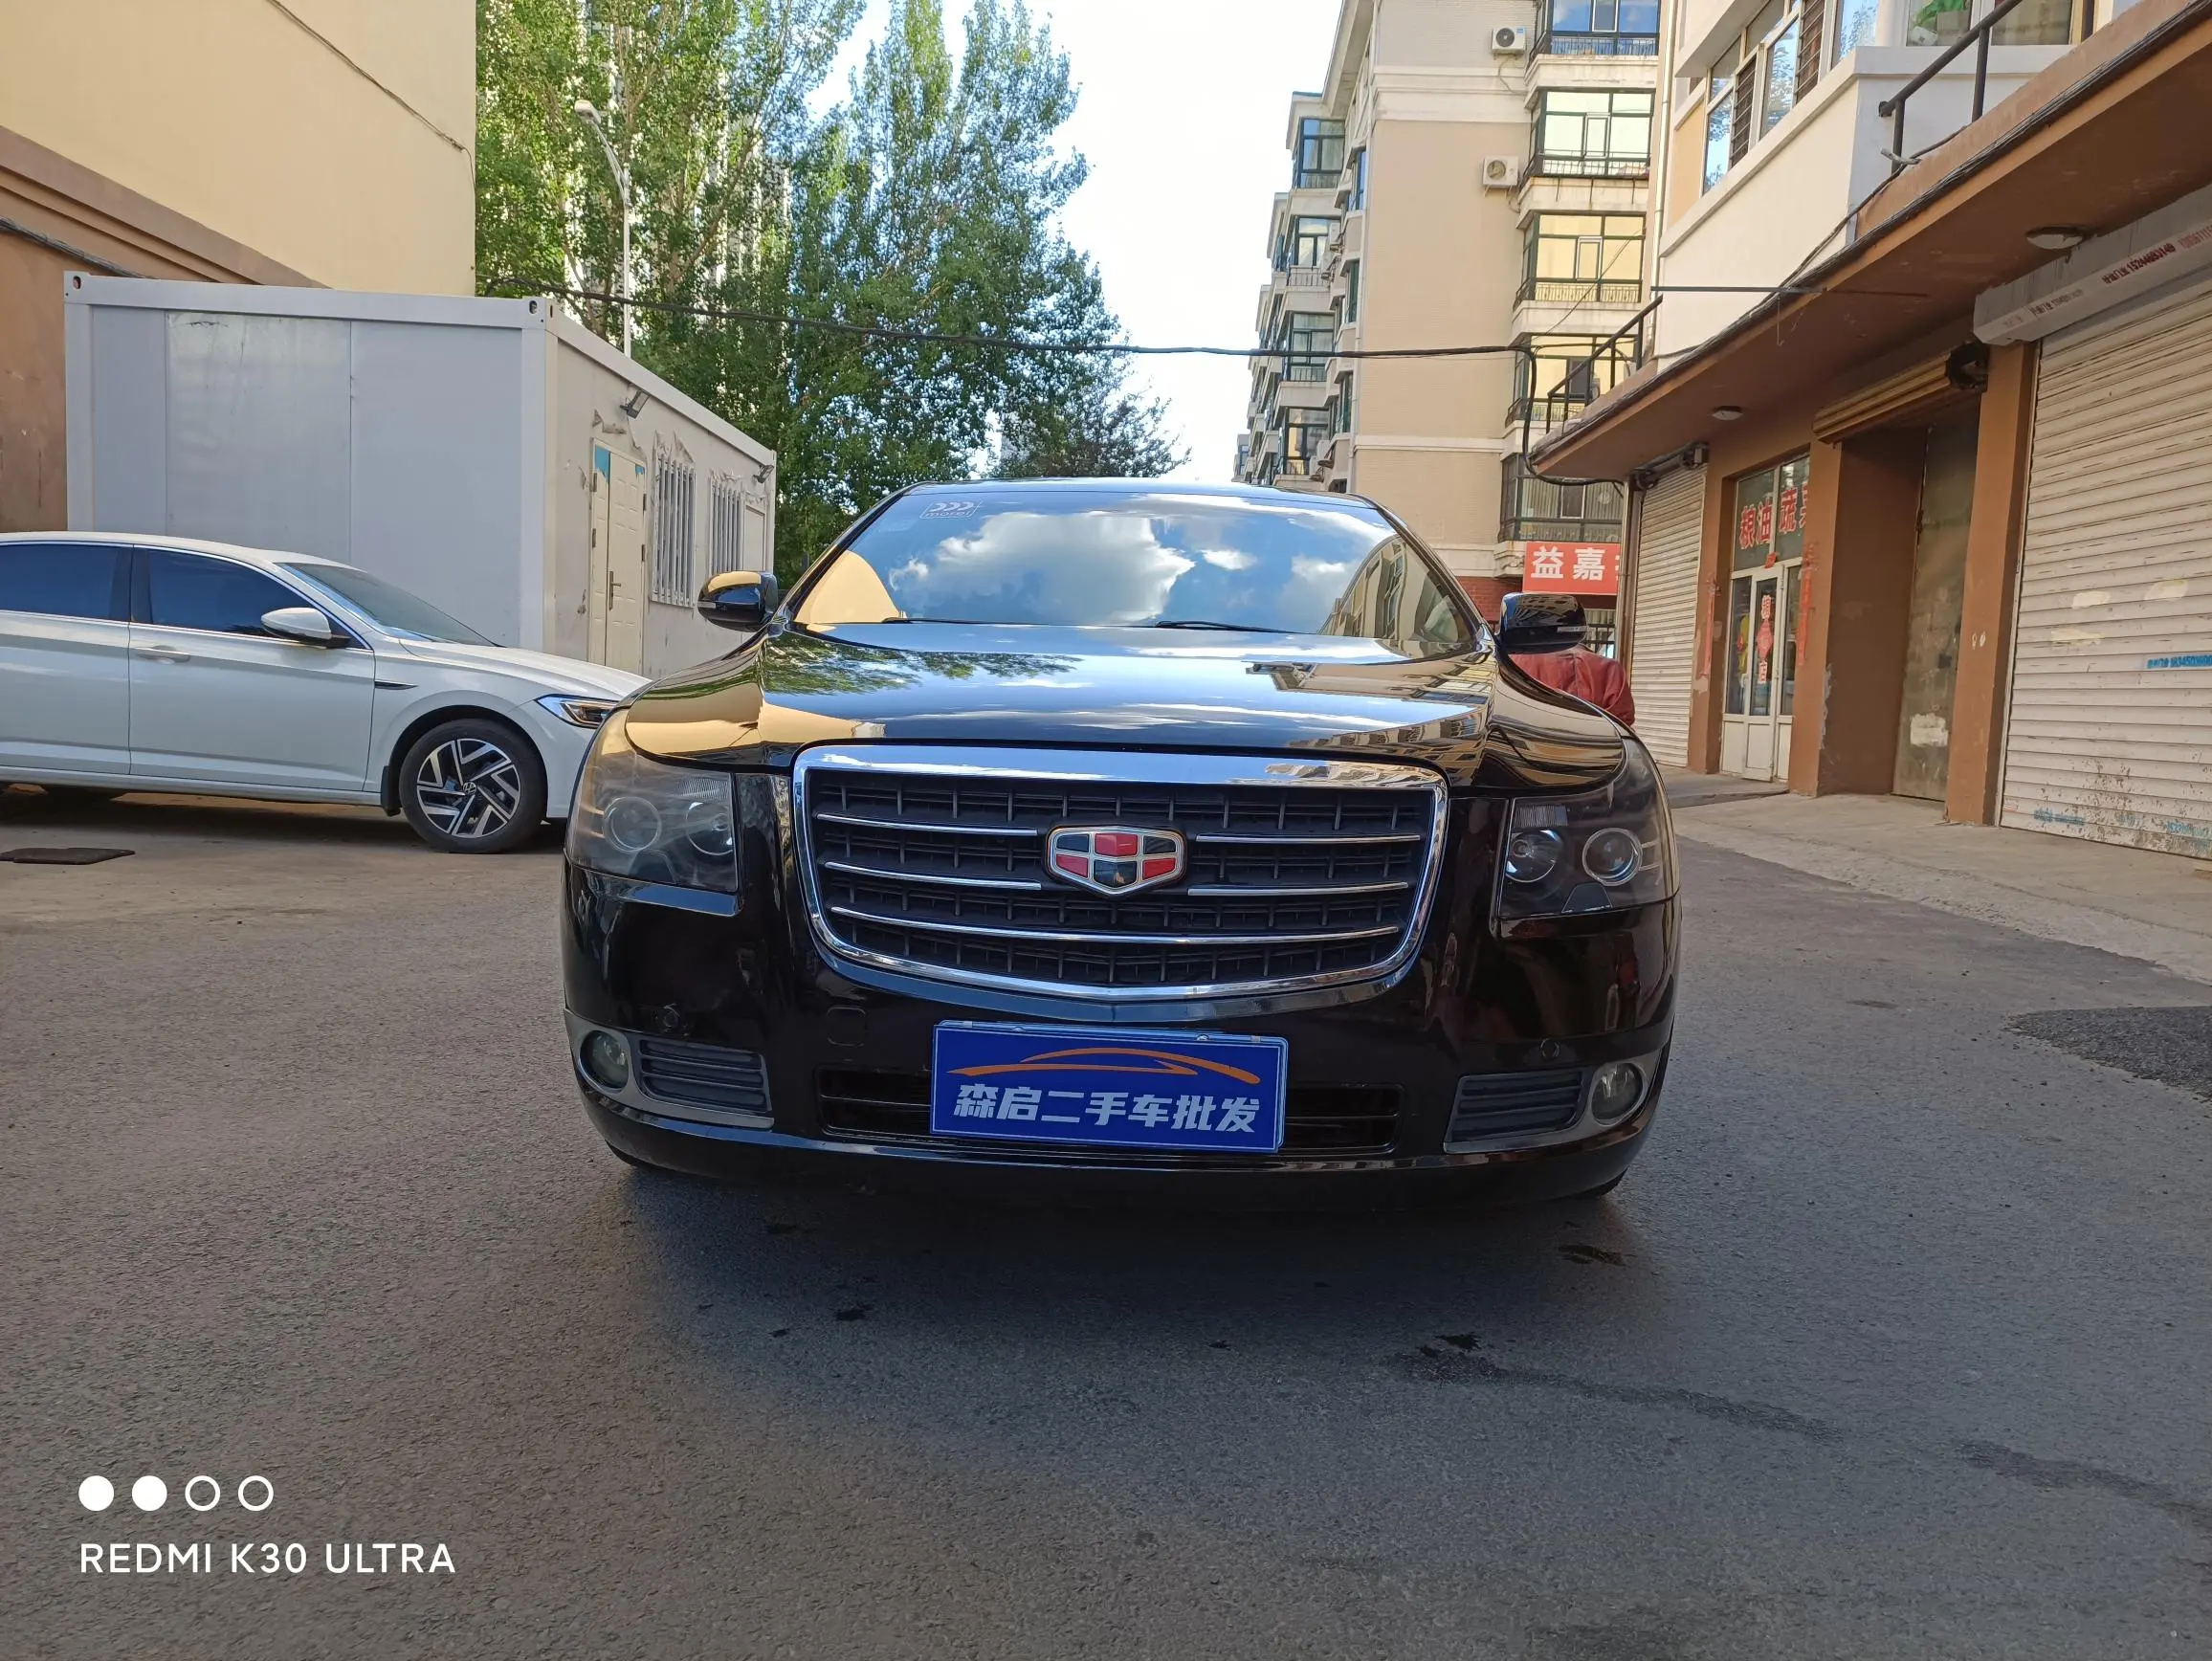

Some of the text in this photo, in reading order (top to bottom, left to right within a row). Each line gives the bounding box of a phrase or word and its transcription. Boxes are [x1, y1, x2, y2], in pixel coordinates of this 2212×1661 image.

[1531, 546, 1620, 580] 益嘉
[953, 1082, 1260, 1133] 森启二手车批发
